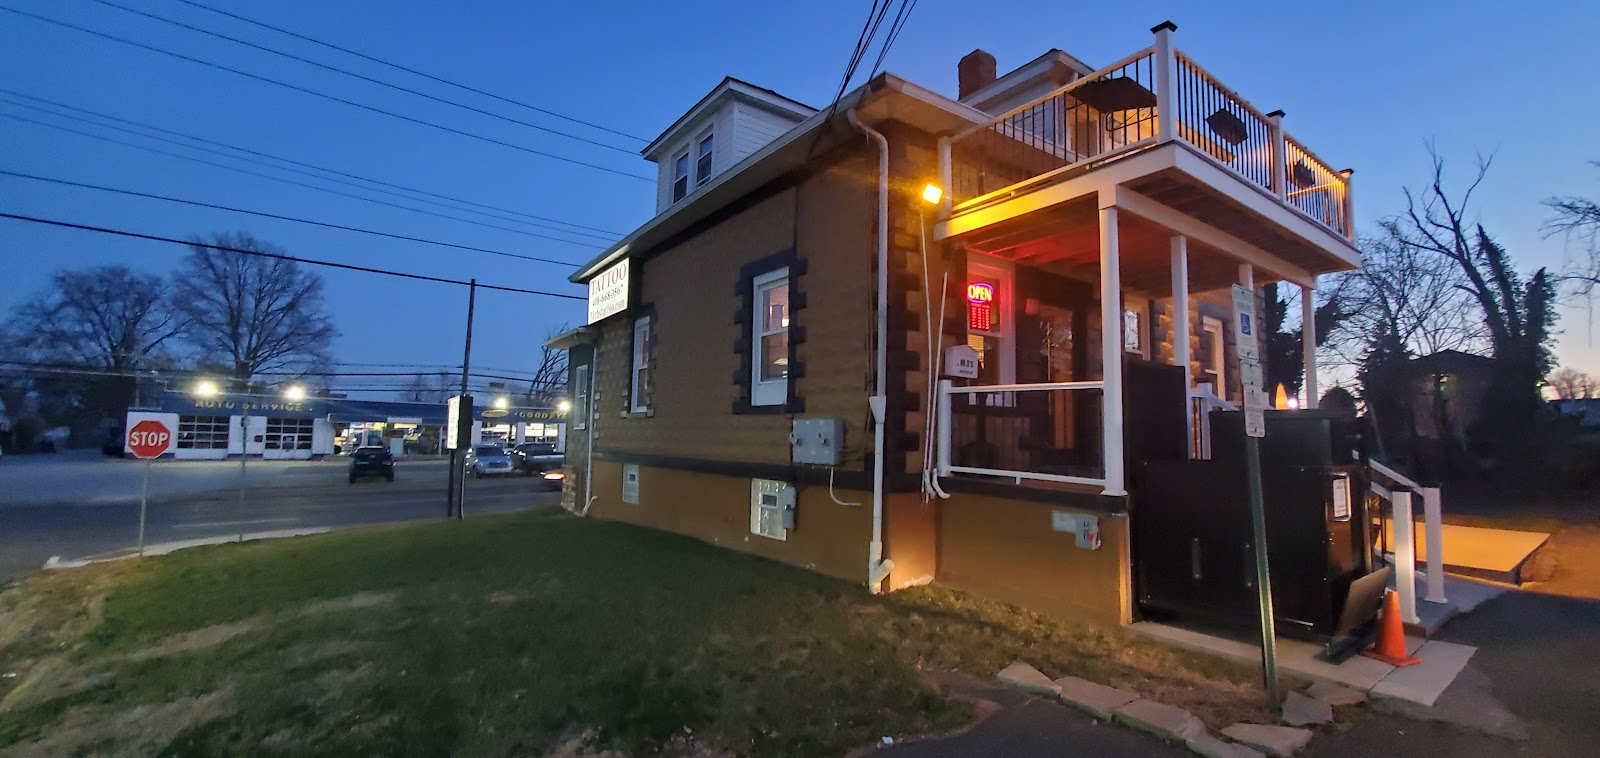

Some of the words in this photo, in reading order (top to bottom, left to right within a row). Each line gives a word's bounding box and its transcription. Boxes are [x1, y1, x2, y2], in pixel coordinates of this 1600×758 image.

[591, 263, 627, 296] TATTOO
[967, 285, 992, 302] OPEN
[195, 400, 235, 409] AUTO
[242, 402, 303, 412] SERVICE
[130, 430, 169, 447] STOP
